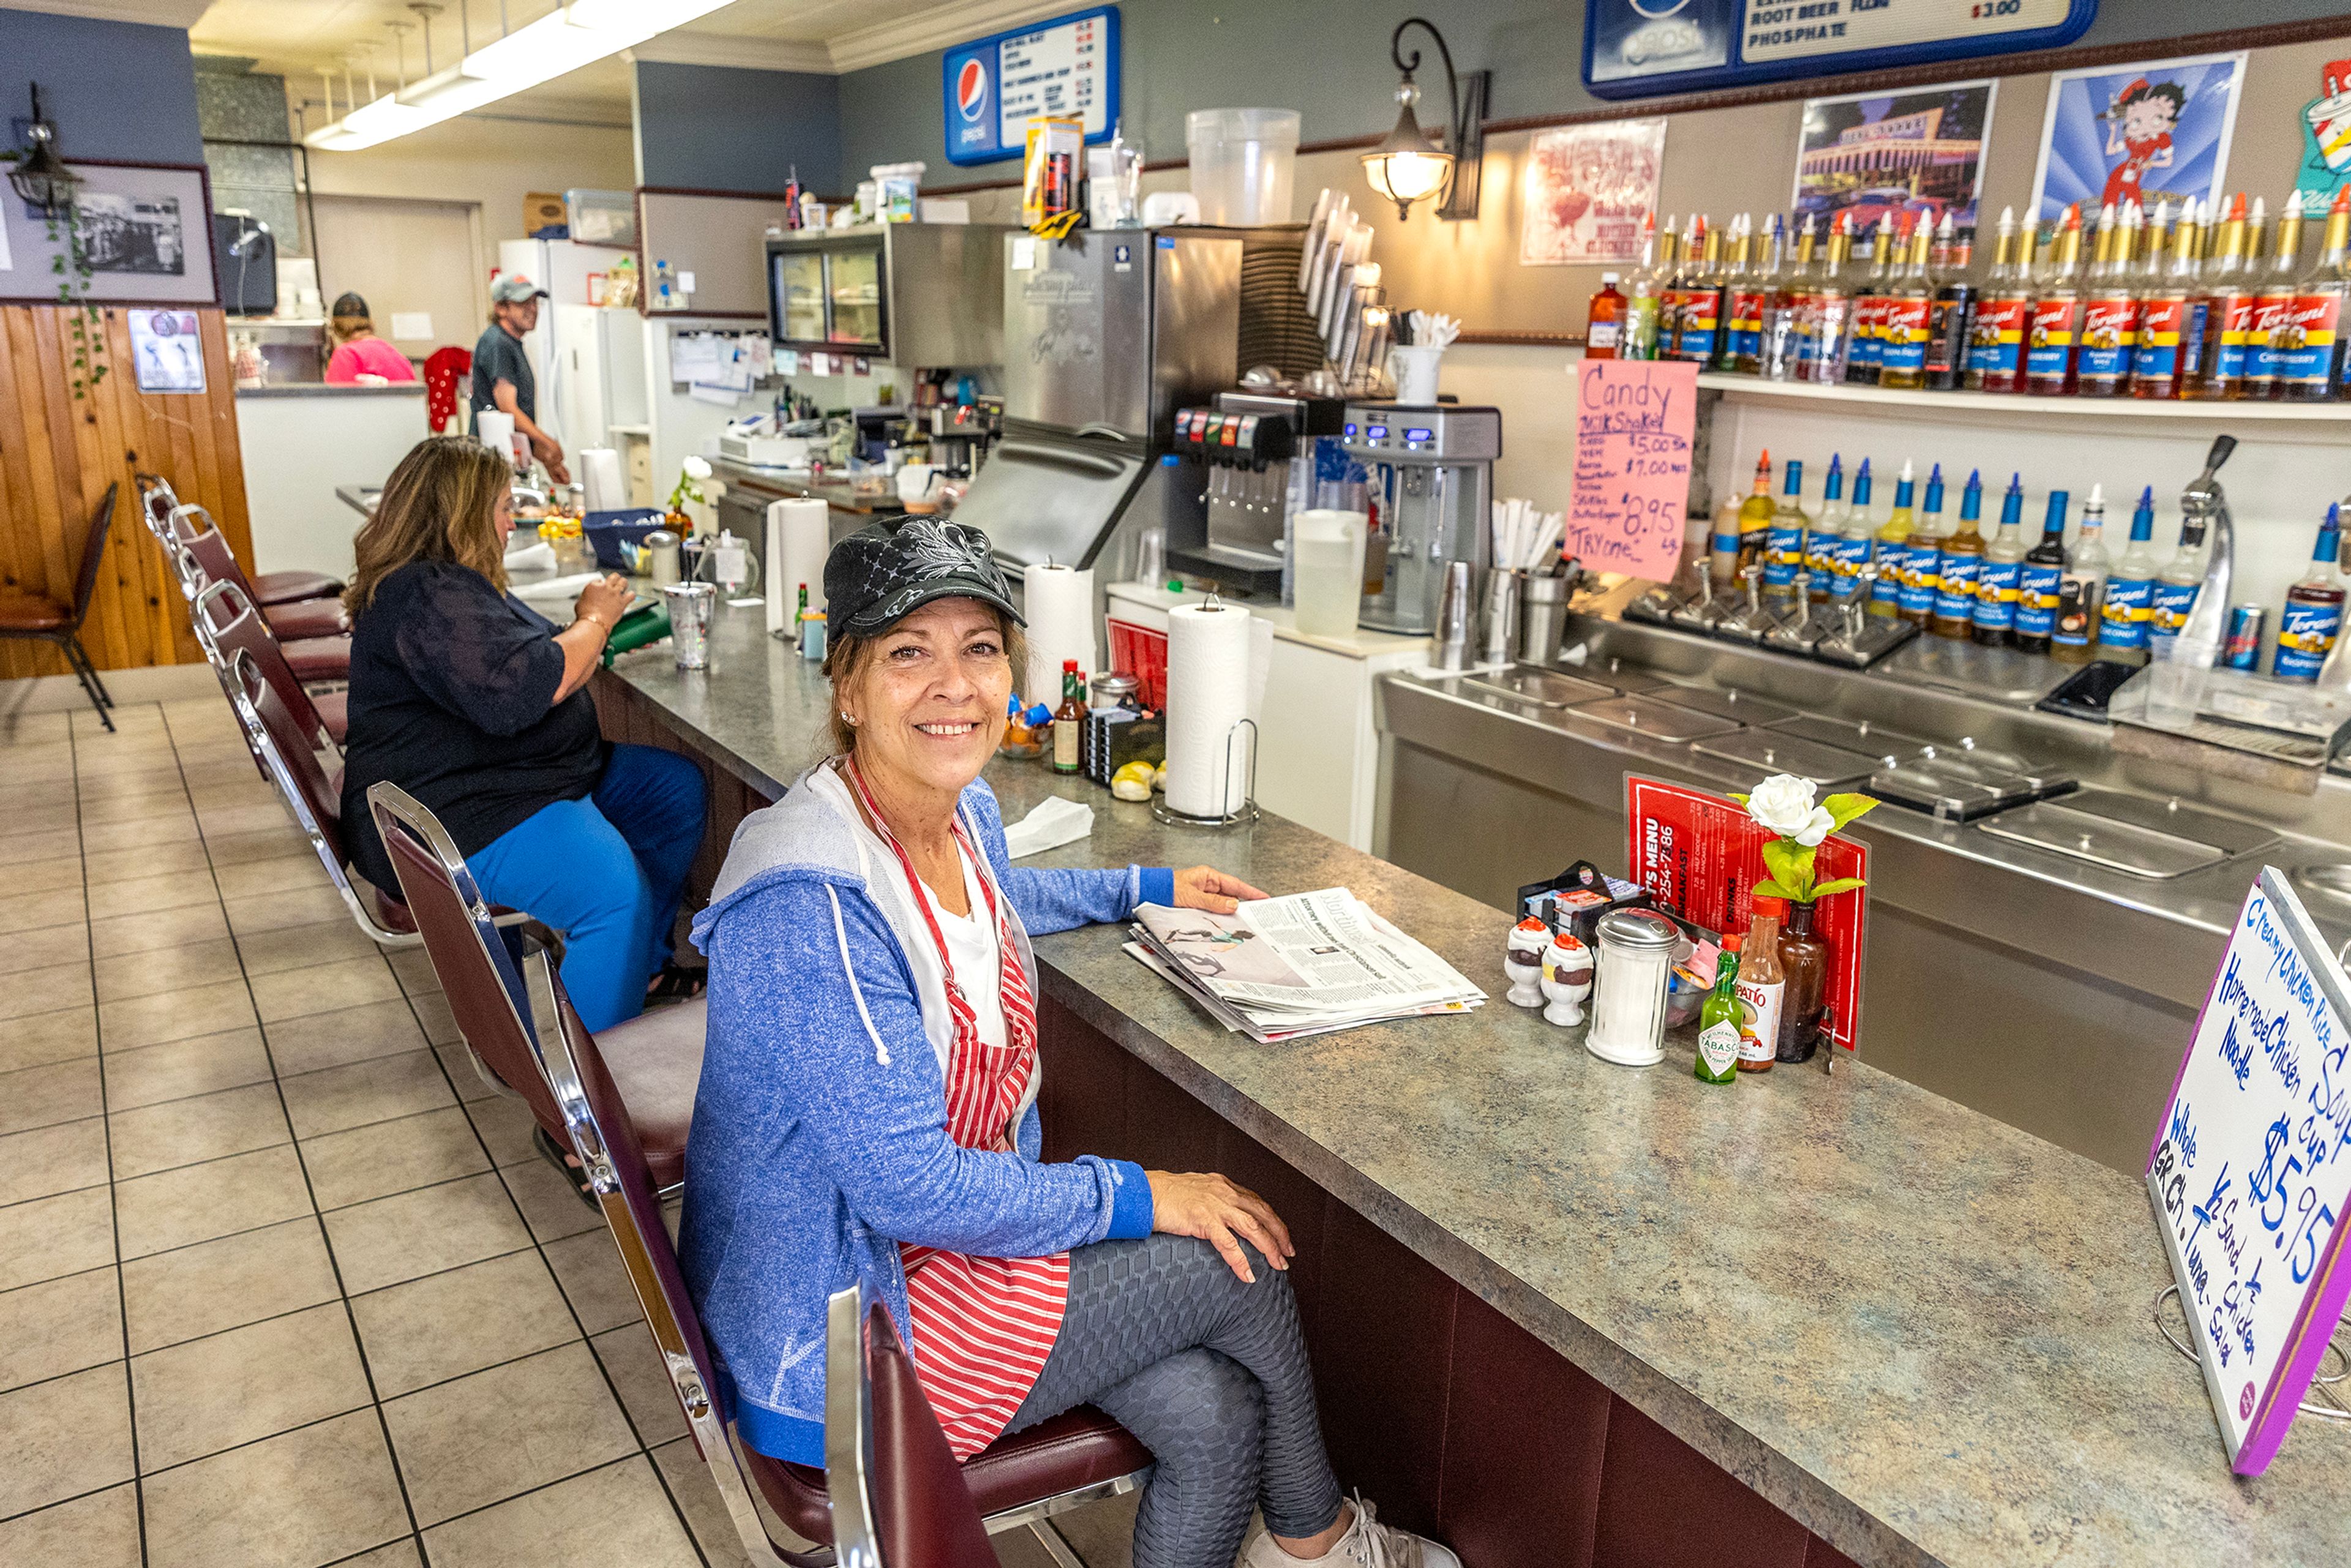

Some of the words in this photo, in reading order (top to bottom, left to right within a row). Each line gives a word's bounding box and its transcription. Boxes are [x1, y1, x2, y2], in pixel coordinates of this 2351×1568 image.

[1750, 7, 1792, 25] ROOT
[1798, 2, 1839, 20] BEER
[1971, 0, 2020, 18] $3.00
[1749, 23, 1847, 48] PHOSPHATE
[1886, 306, 1927, 329] Torani
[2085, 306, 2136, 332] Torani
[1582, 363, 1672, 433] Candy
[1978, 566, 2017, 584] Torani
[2020, 571, 2058, 590] Torani
[2104, 583, 2150, 604] Torani
[2153, 588, 2194, 607] Torani
[1646, 817, 1659, 869] MENU
[1678, 847, 1688, 919] BREAKFAST
[1300, 898, 1318, 921] Attorney
[1726, 877, 1736, 923] DRINKS
[2246, 897, 2284, 983] Creamy
[2279, 948, 2314, 1018] Chicken
[2311, 997, 2331, 1051] Rice
[1736, 983, 1766, 1007] PATÍO
[2218, 951, 2270, 1041] Homemade
[2265, 1010, 2301, 1099] Chicken
[2298, 1114, 2328, 1176] Cup
[2169, 1097, 2198, 1169] Whole
[2218, 1015, 2254, 1092] Noodle
[2249, 1111, 2336, 1285] $5.95
[2223, 1279, 2256, 1365] Chicken
[2209, 1305, 2231, 1368] Salad
